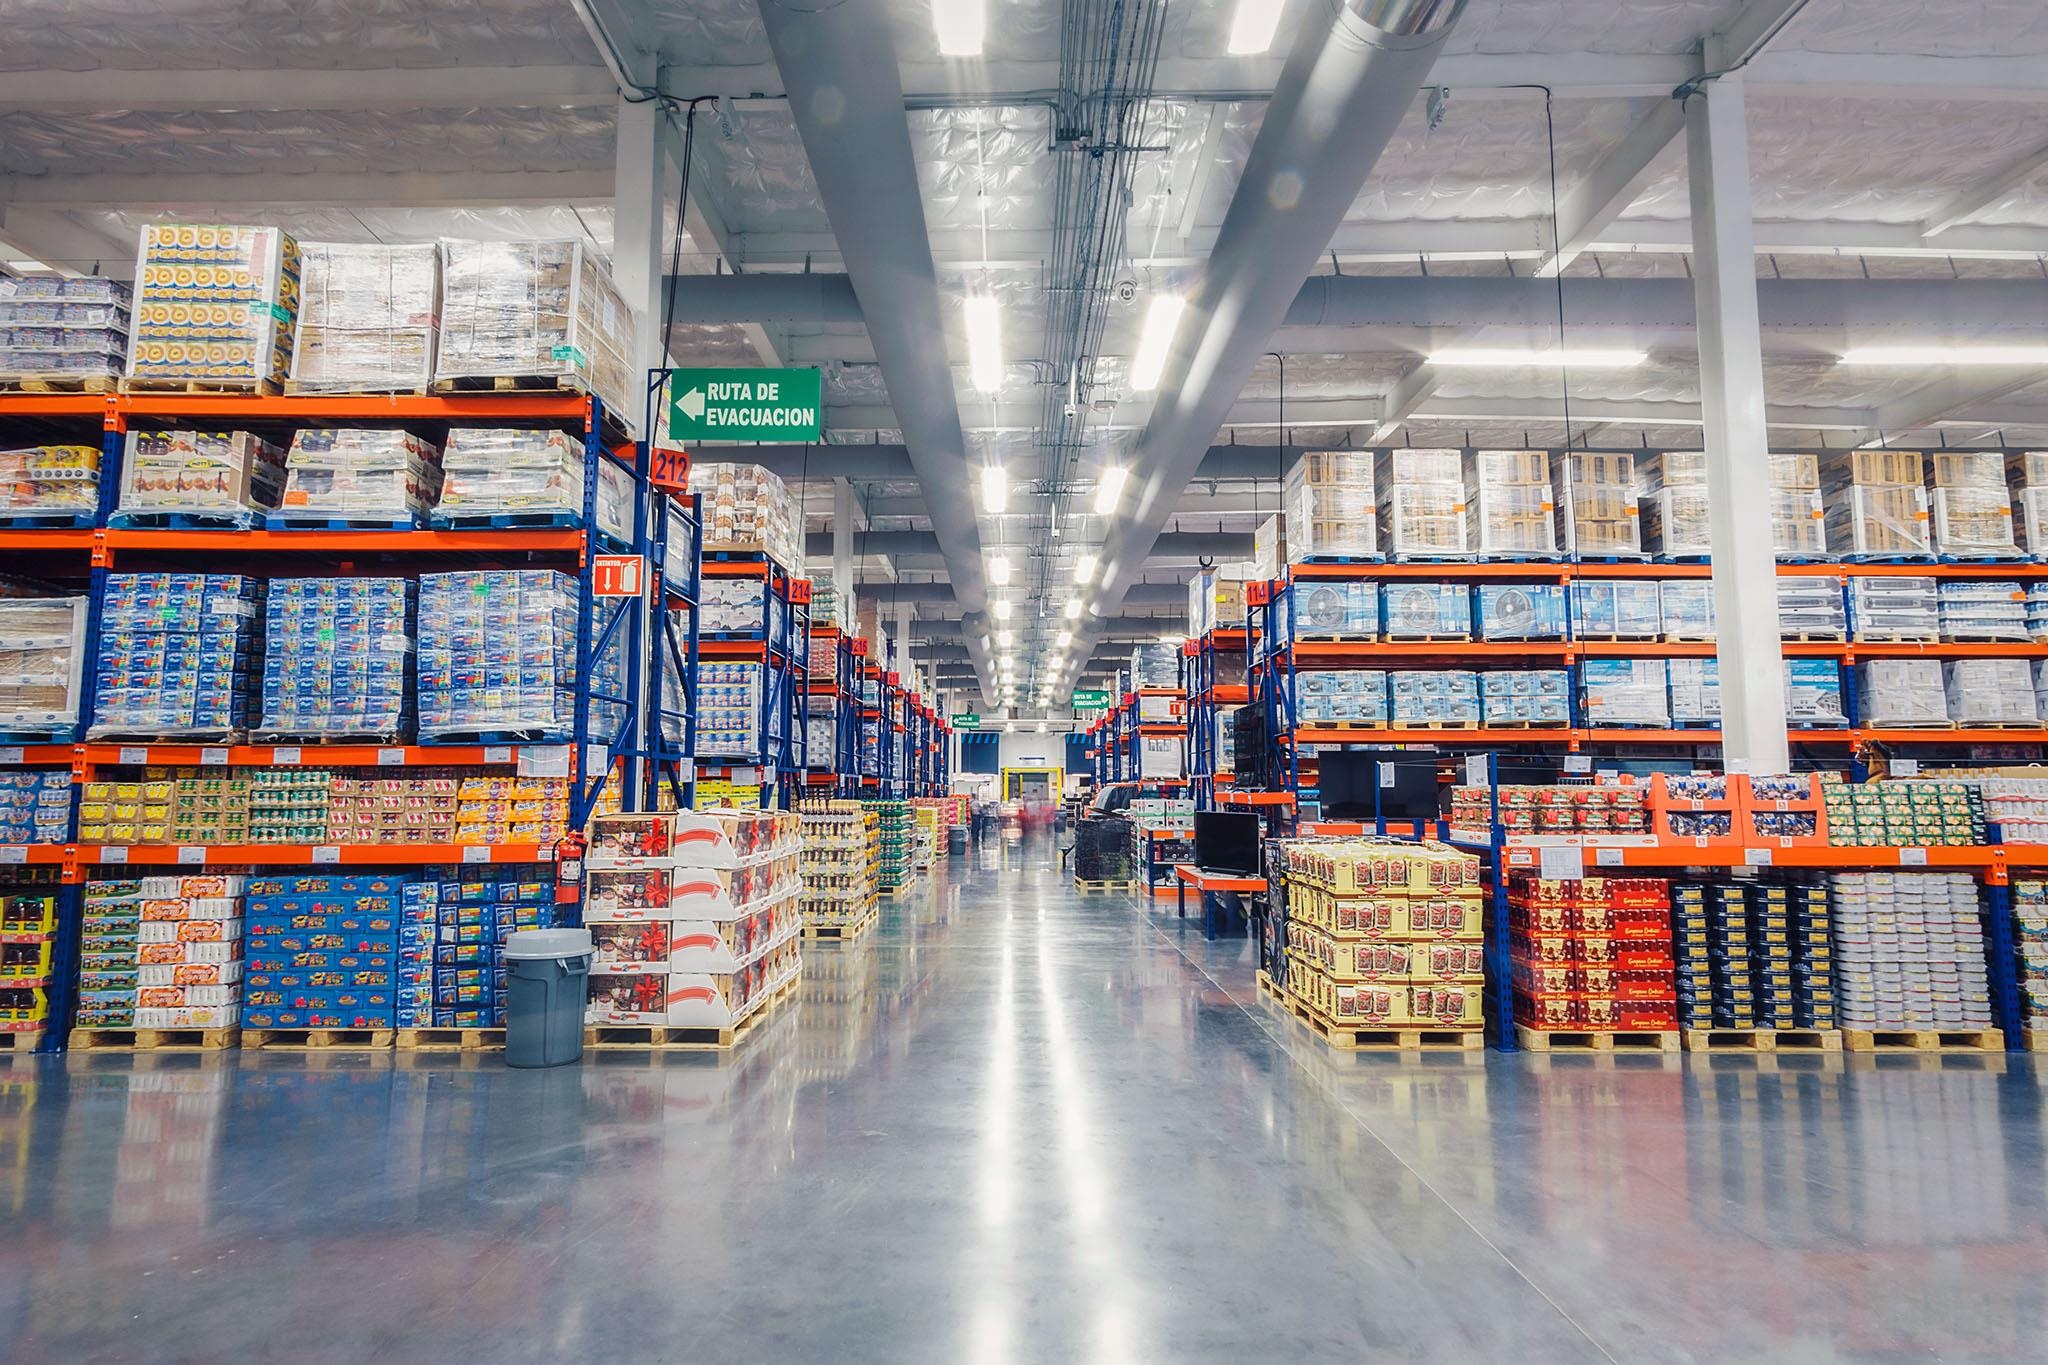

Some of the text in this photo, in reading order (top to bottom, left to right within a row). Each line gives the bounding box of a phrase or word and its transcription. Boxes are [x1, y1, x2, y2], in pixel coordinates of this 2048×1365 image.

[708, 383, 779, 401] RUTA DE
[706, 407, 815, 427] EVACUACION
[656, 453, 687, 484] 212
[791, 582, 810, 600] 214
[1247, 585, 1266, 601] 114
[854, 640, 868, 653] 216
[1185, 641, 1198, 653] 116
